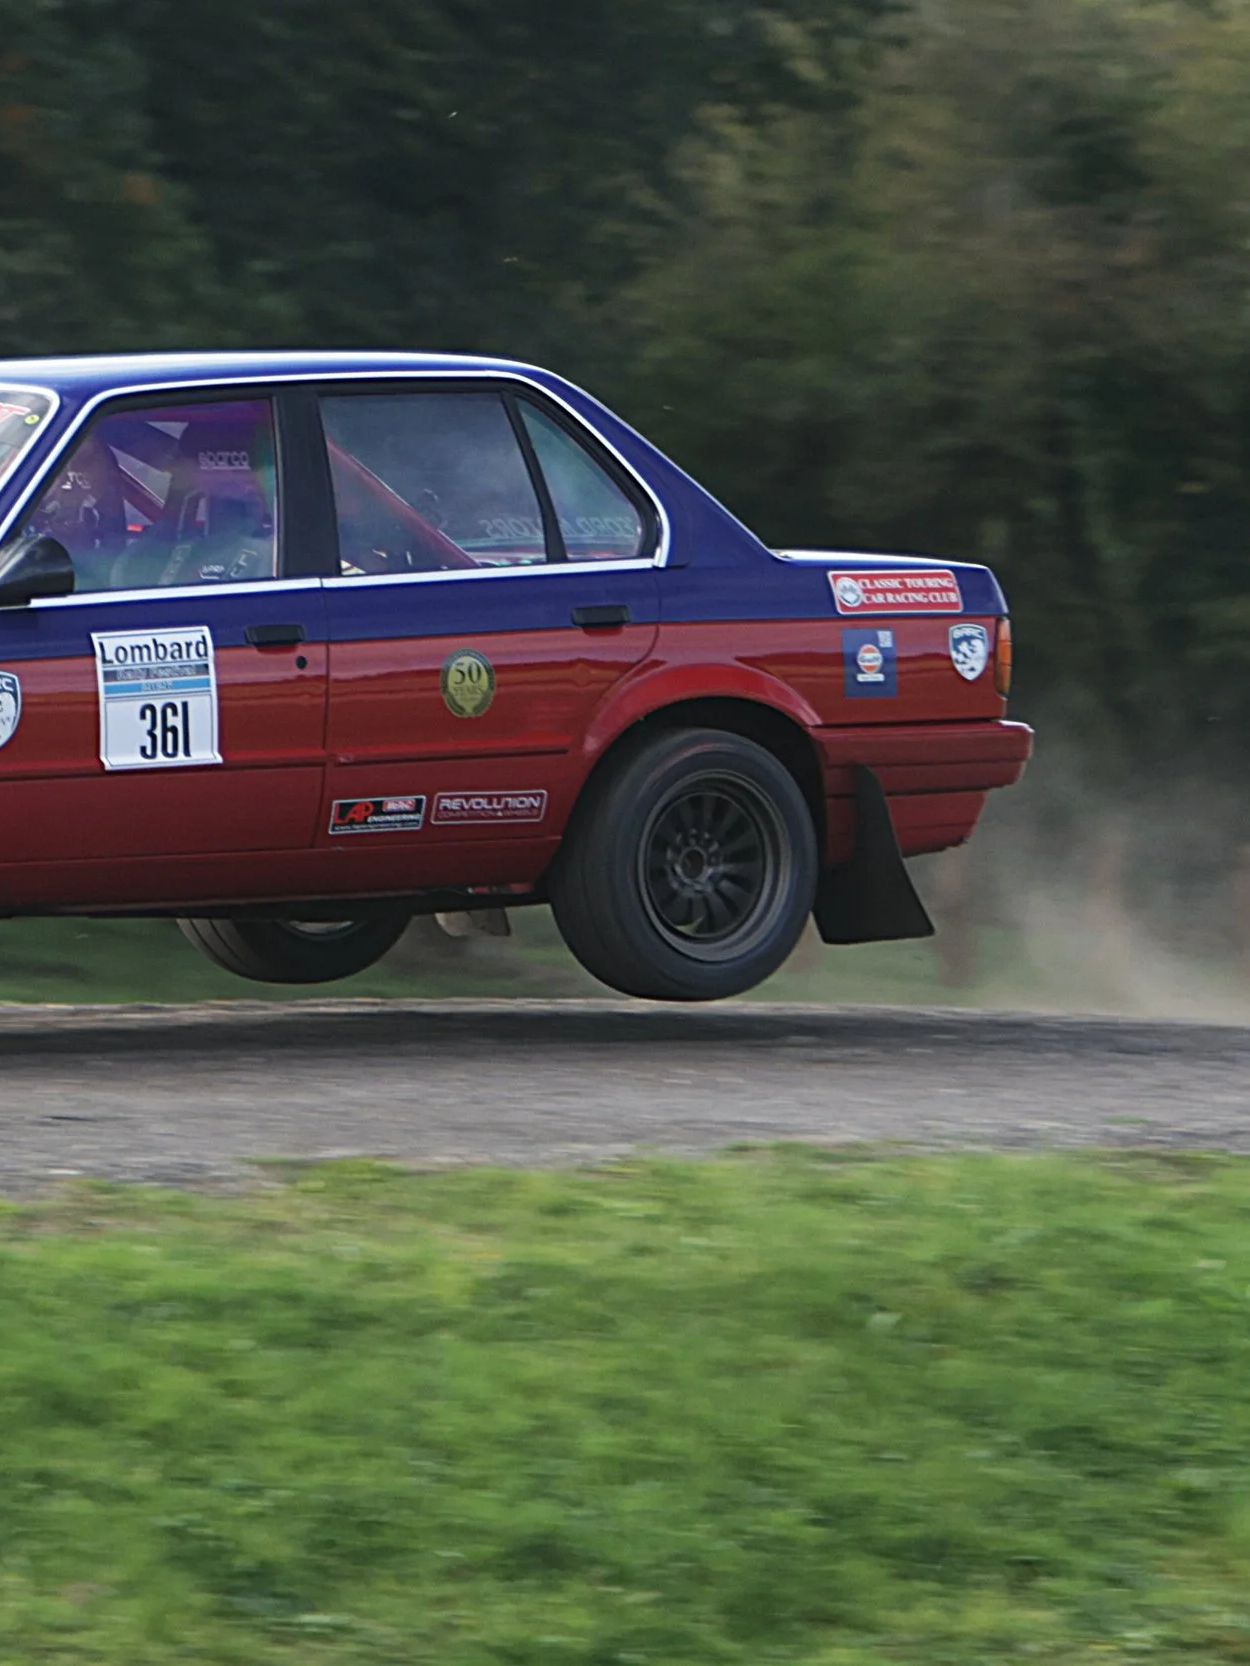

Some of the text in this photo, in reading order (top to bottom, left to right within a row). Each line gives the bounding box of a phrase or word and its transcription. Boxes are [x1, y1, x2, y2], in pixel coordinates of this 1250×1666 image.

[857, 577, 954, 589] CLASSIC TOURING
[863, 592, 958, 604] CAR RACING CLUB
[99, 634, 209, 664] Lombard
[453, 661, 481, 685] 50
[139, 701, 192, 760] 361
[439, 796, 542, 811] REVOLUTION
